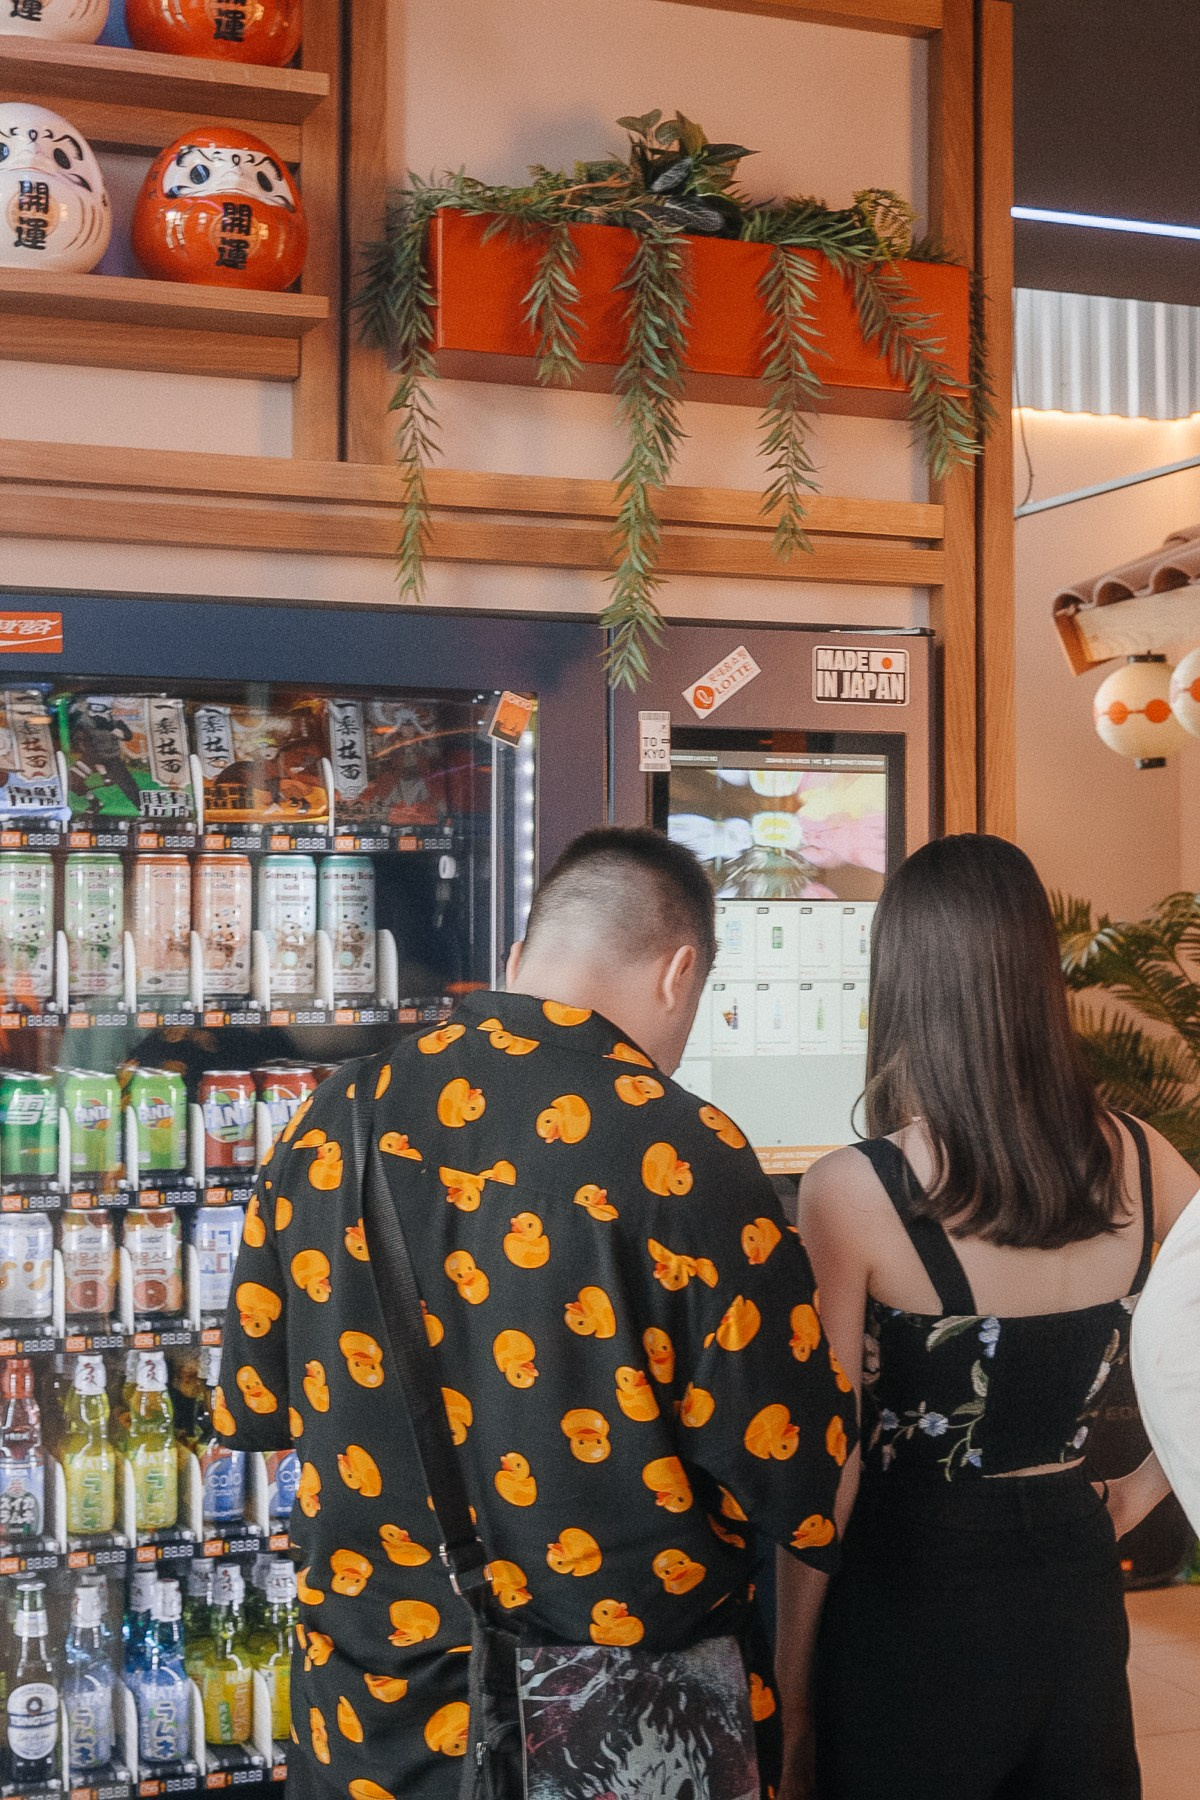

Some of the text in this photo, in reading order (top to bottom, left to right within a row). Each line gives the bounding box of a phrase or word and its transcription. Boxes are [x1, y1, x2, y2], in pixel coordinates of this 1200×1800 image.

[14, 180, 50, 250] 開運
[216, 201, 252, 270] 開運
[715, 662, 751, 694] LOTTE
[817, 649, 869, 672] MADE
[817, 670, 904, 700] IN JAPAN
[73, 1709, 94, 1761] ラムネ
[154, 1702, 177, 1757] ラムネ
